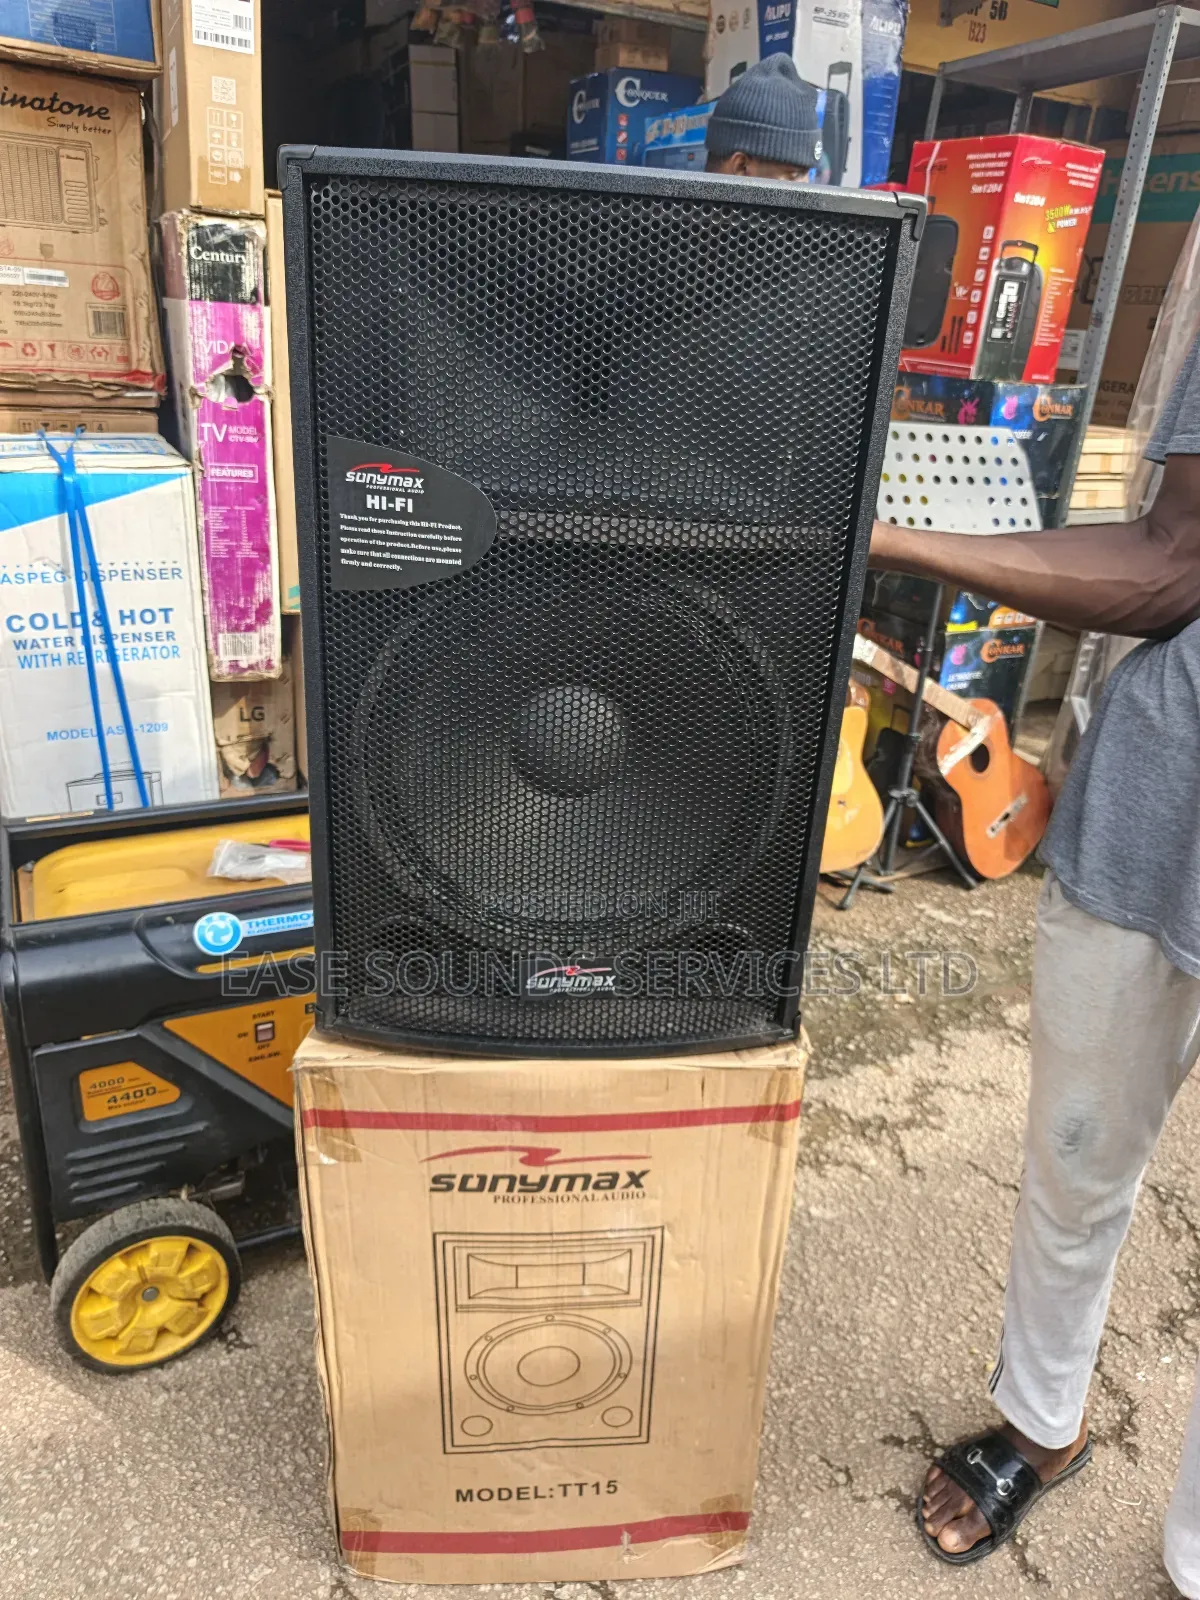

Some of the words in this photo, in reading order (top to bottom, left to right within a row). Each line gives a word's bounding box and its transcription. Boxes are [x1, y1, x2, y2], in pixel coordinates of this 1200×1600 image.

[46, 116, 79, 133] Simply
[82, 123, 112, 135] better
[1102, 165, 1200, 196] Hens
[190, 246, 247, 264] Century
[201, 423, 228, 443] TV
[229, 426, 258, 435] MODEL
[210, 467, 255, 478] FEATURES
[366, 484, 406, 493] PROFESSIONAL
[366, 494, 413, 513] HI-FI
[340, 513, 357, 521] Thank
[378, 518, 409, 527] purchasing
[418, 532, 443, 541] carefully
[443, 534, 462, 542] before
[341, 558, 360, 567] firmly
[373, 562, 403, 571] correctly.
[391, 553, 425, 562] connections
[436, 558, 462, 566] mounted
[80, 567, 183, 582] DSPENSER
[6, 611, 85, 633] COLD
[119, 608, 174, 626] HOT
[13, 636, 75, 651] WATER
[81, 631, 177, 646] ISPENSER
[18, 654, 62, 669] WITH
[240, 706, 265, 722] LG
[106, 723, 169, 737] AS-1209
[246, 912, 314, 929] THERMO
[252, 1010, 275, 1020] START
[89, 1076, 125, 1089] 4000
[107, 1086, 157, 1104] 4400
[493, 1193, 597, 1205] PROFESSIONAL
[601, 1190, 647, 1201] AUDIO
